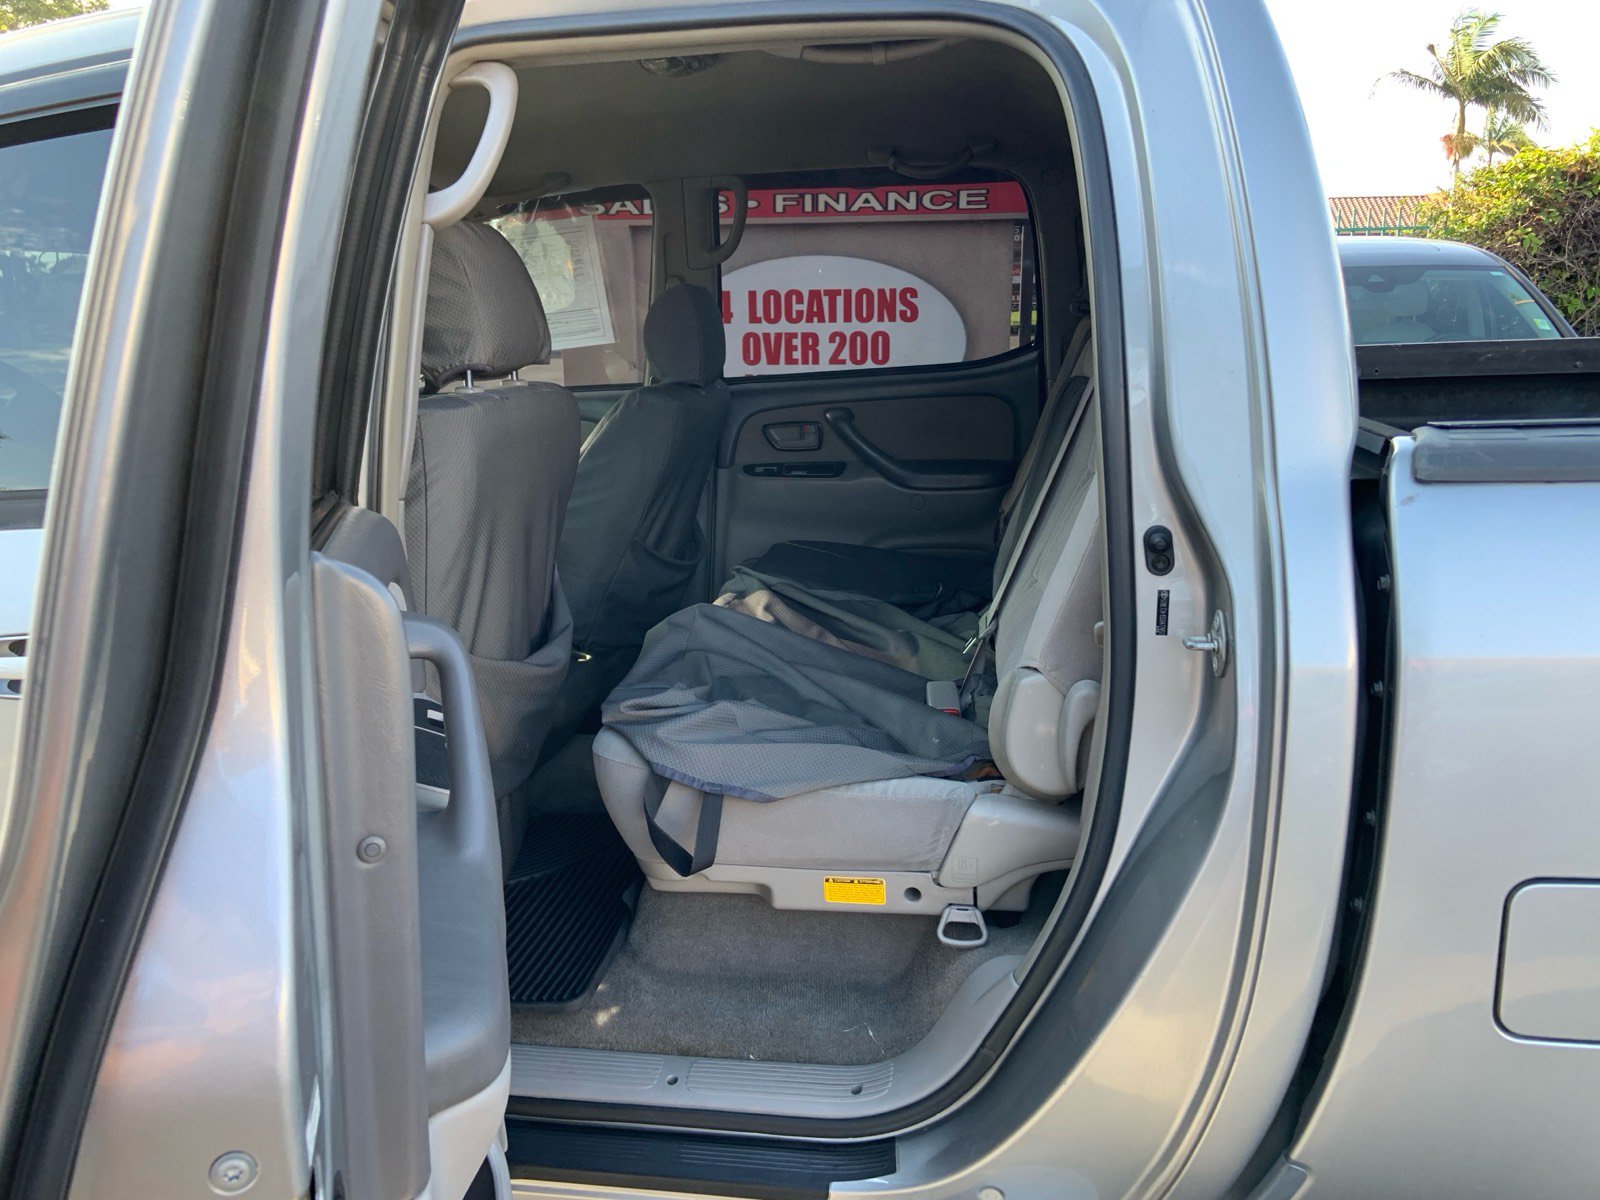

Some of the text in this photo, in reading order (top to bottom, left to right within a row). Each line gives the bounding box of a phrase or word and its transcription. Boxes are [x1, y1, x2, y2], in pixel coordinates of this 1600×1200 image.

[773, 188, 989, 213] FINANCE
[748, 287, 919, 324] LOCATIONS
[742, 330, 890, 366] OVER 200
